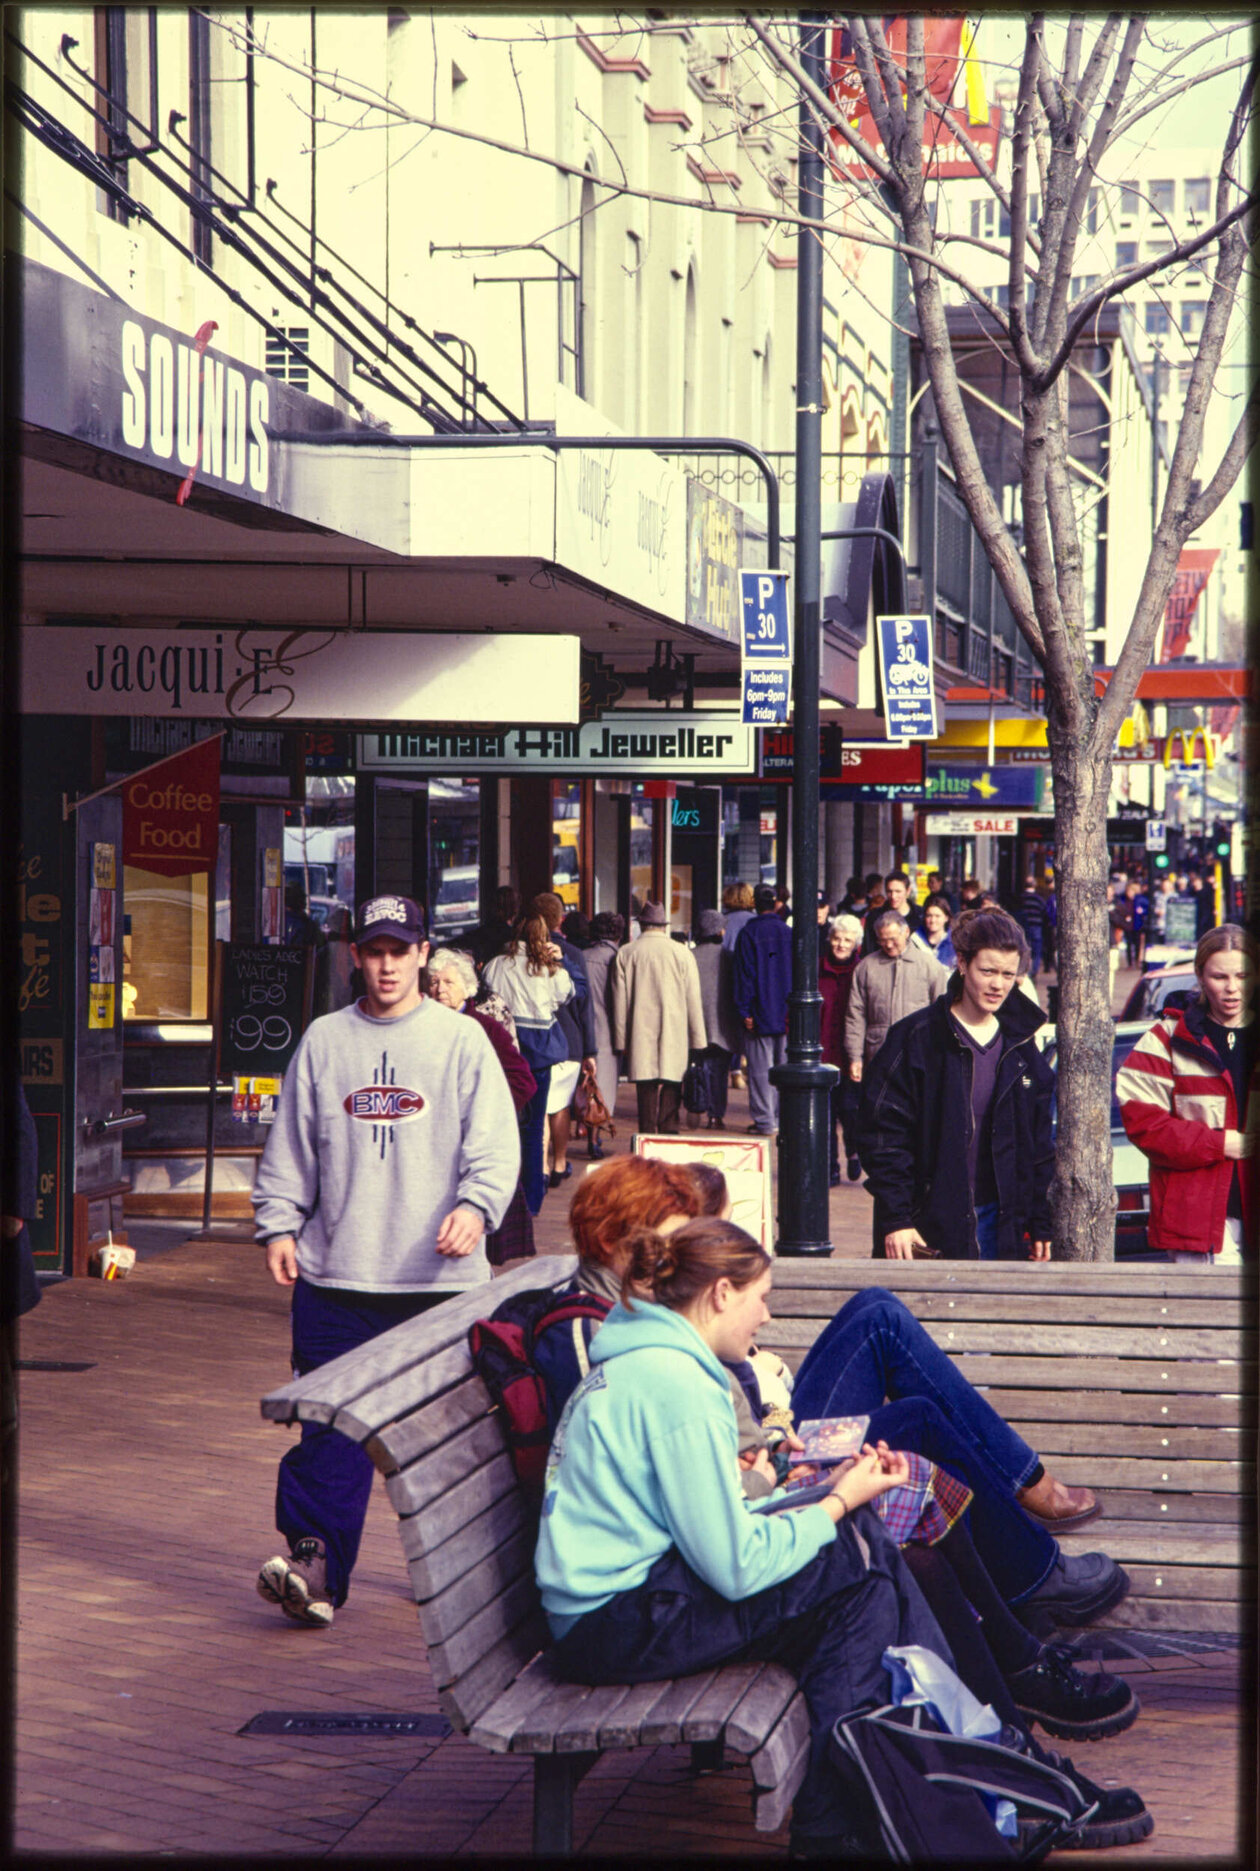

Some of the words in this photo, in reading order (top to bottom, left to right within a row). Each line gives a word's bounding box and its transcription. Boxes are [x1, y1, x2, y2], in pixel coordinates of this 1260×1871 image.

[122, 320, 270, 493] SOUNDS
[758, 577, 774, 610] P
[757, 613, 776, 639] 30
[895, 620, 913, 644] P
[896, 643, 916, 663] 30
[87, 634, 225, 708] Jacqui
[750, 671, 784, 685] Includes
[746, 688, 786, 703] 6pm-9pm
[752, 706, 777, 722] Friday
[514, 728, 580, 758] Hill
[590, 727, 733, 758] Jeweller
[925, 768, 970, 800] plus
[128, 783, 213, 812] Coffee
[139, 821, 201, 849] Food
[973, 819, 1014, 833] SALE
[236, 963, 288, 985] WATCH
[353, 1092, 419, 1116] BMC
